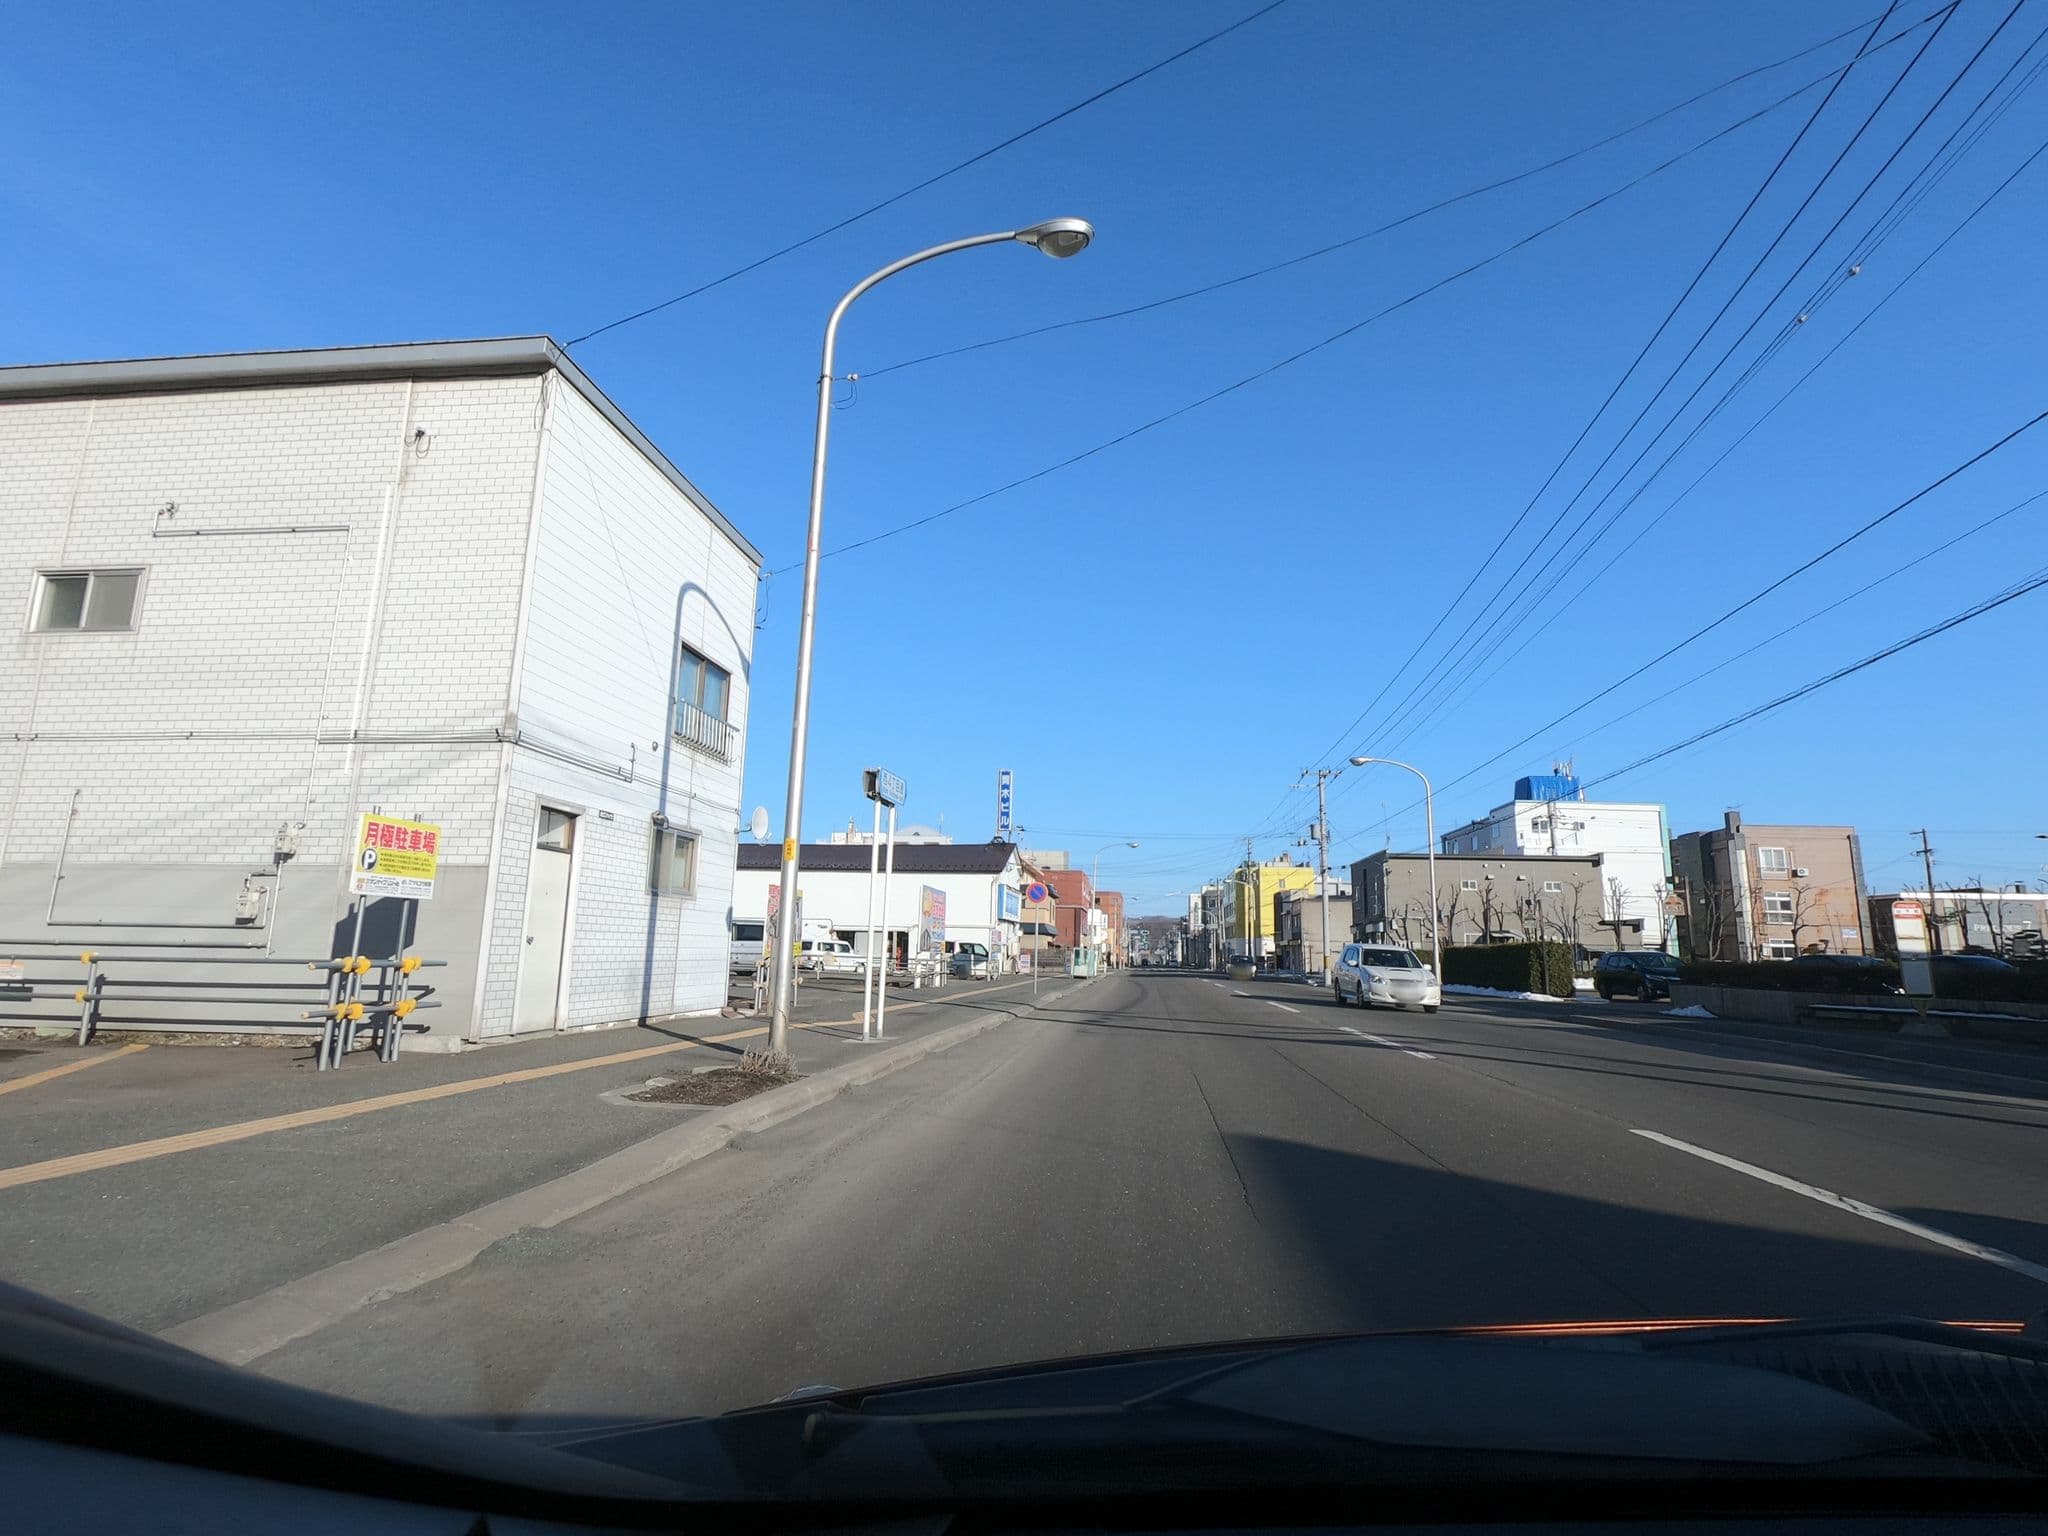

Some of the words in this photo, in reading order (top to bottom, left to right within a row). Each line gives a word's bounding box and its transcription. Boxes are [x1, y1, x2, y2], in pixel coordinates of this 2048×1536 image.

[364, 822, 436, 854] 月極駐車場
